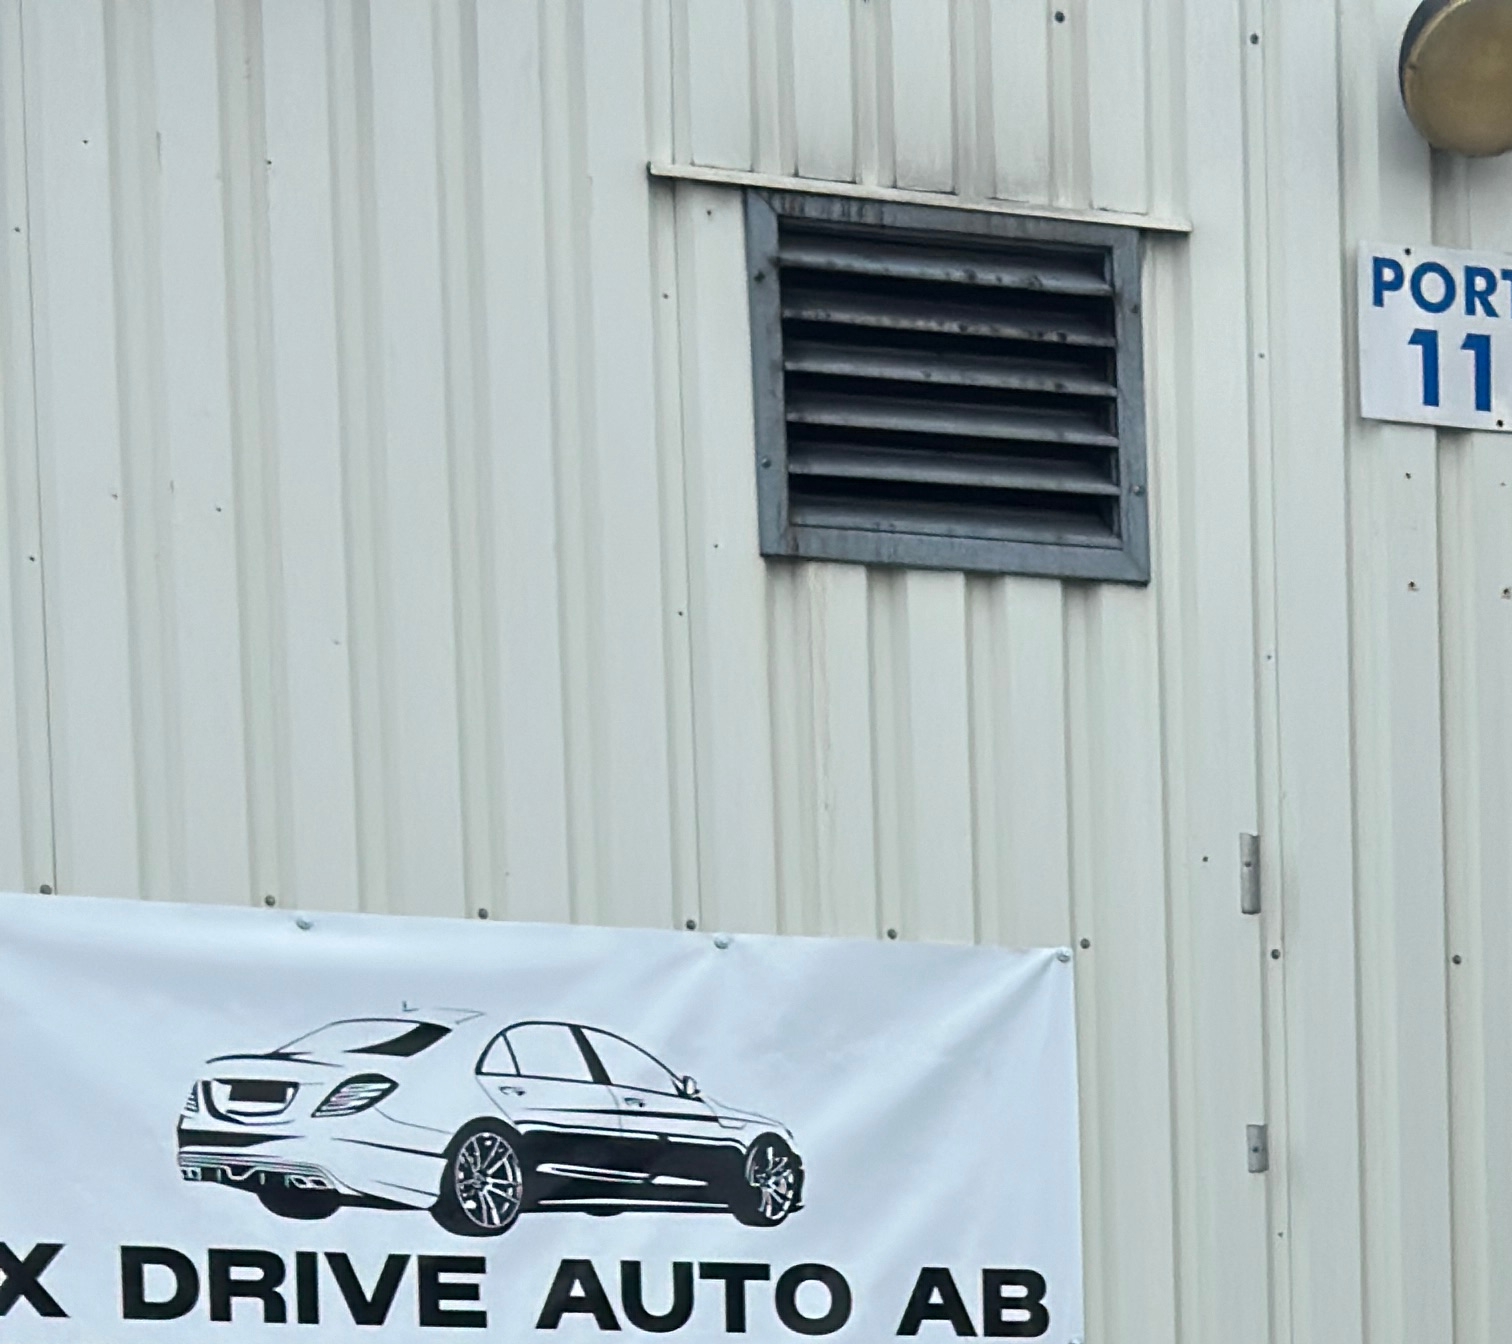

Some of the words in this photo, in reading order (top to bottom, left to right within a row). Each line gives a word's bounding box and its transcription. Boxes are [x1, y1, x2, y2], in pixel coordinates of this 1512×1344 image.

[1407, 327, 1492, 413] 11
[0, 1242, 71, 1318] X
[120, 1244, 488, 1329] DRIVE
[535, 1258, 853, 1337] AUTO
[896, 1266, 1051, 1338] AB
